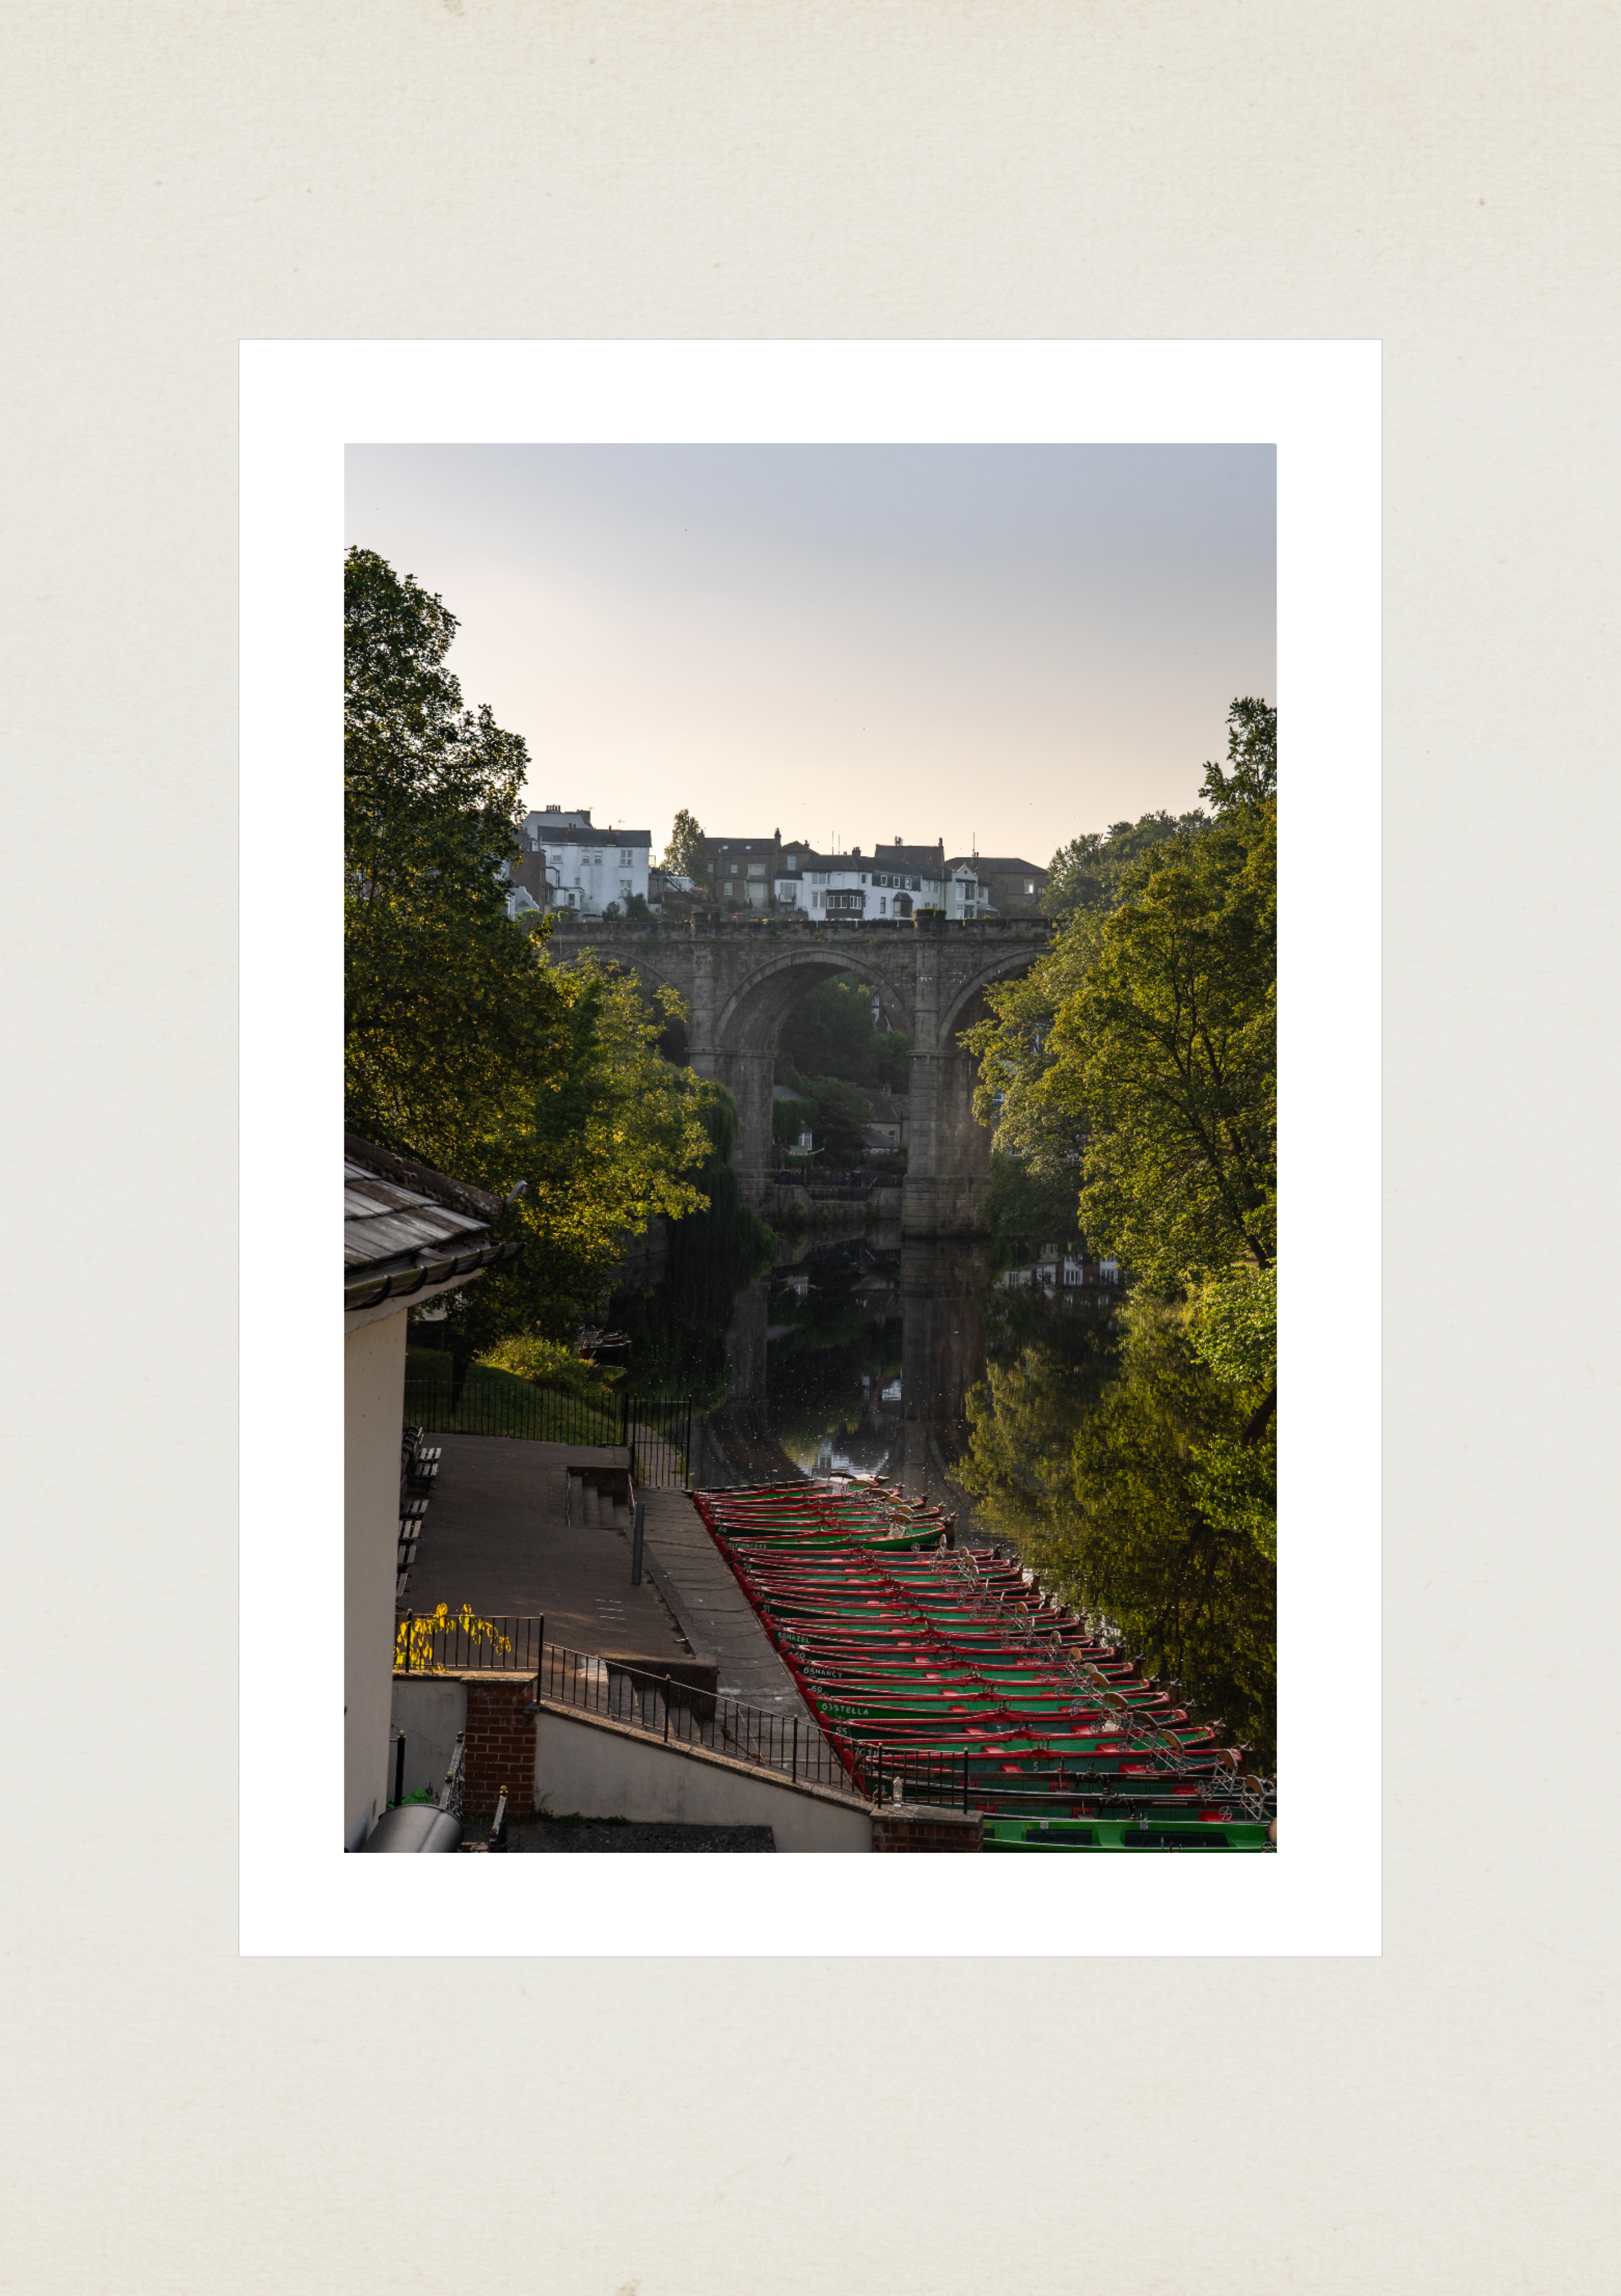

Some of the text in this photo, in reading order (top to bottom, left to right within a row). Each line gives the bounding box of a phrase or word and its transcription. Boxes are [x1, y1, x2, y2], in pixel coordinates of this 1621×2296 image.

[763, 1604, 770, 1612] 57
[778, 1632, 810, 1644] 58 HAZEL
[803, 1666, 843, 1678] 65 NANCY
[821, 1702, 869, 1715] 63 STELLA
[836, 1727, 848, 1735] 55
